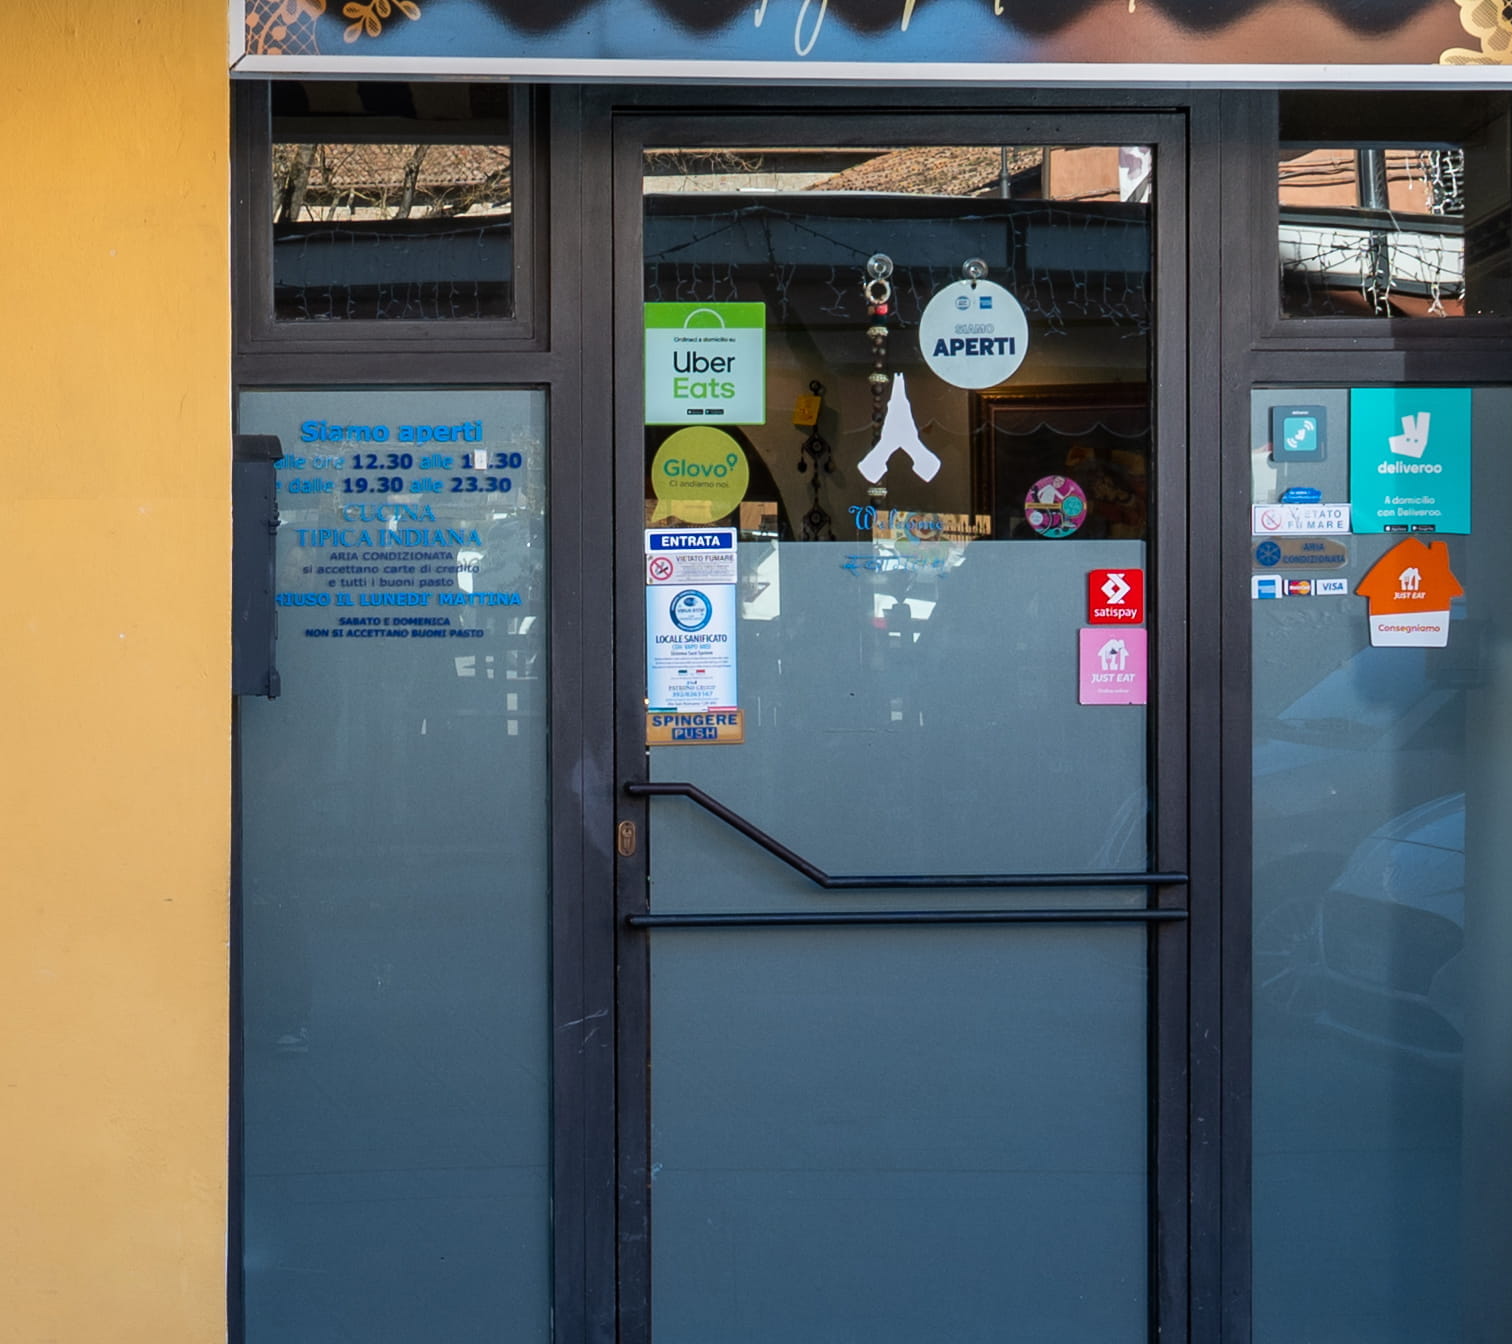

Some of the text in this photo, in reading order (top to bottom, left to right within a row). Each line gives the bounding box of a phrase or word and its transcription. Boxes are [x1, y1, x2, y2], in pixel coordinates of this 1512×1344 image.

[932, 337, 1016, 357] APERTI
[673, 351, 736, 373] Uber
[673, 377, 736, 399] Eats
[300, 420, 484, 446] Siamo aperti
[273, 452, 523, 470] alle ore 12.30 alle 1.30
[663, 458, 728, 478] Glovo
[1377, 460, 1443, 474] deliveroo
[288, 477, 334, 494] dalle
[342, 477, 404, 494] 19.30
[410, 477, 444, 494] alle
[450, 477, 513, 494] 23.30
[679, 480, 714, 488] andiamo
[1384, 495, 1436, 505] A domicilio
[342, 504, 437, 523] CUCINA
[1377, 509, 1395, 517] con
[296, 528, 483, 547] TIPICA INDIANA
[661, 535, 721, 547] ENTRATA
[330, 551, 454, 561] ARIA CONDIZIONATA
[704, 554, 734, 562] FUMARE
[302, 563, 480, 574] si accettano carte di credito
[328, 579, 336, 587] e
[340, 577, 367, 587] tutti
[380, 577, 415, 587] buoni
[419, 578, 454, 590] pasto
[1322, 582, 1344, 591] VISA
[275, 592, 330, 606] HIUSO
[336, 592, 354, 606] IL
[439, 592, 522, 606] MATTINA
[1393, 592, 1411, 600] JUST
[1093, 608, 1138, 619] satispay
[338, 617, 451, 626] SABATO E DOMENICA
[305, 628, 484, 638] NON SI ACCETTANO BUONI PASTO
[1378, 623, 1441, 633] Consegniamo
[656, 634, 728, 644] LOCALE SANIFICATO
[1091, 673, 1136, 683] JUST EAT
[652, 713, 738, 727] SPINGERE
[675, 728, 716, 739] PUSH
